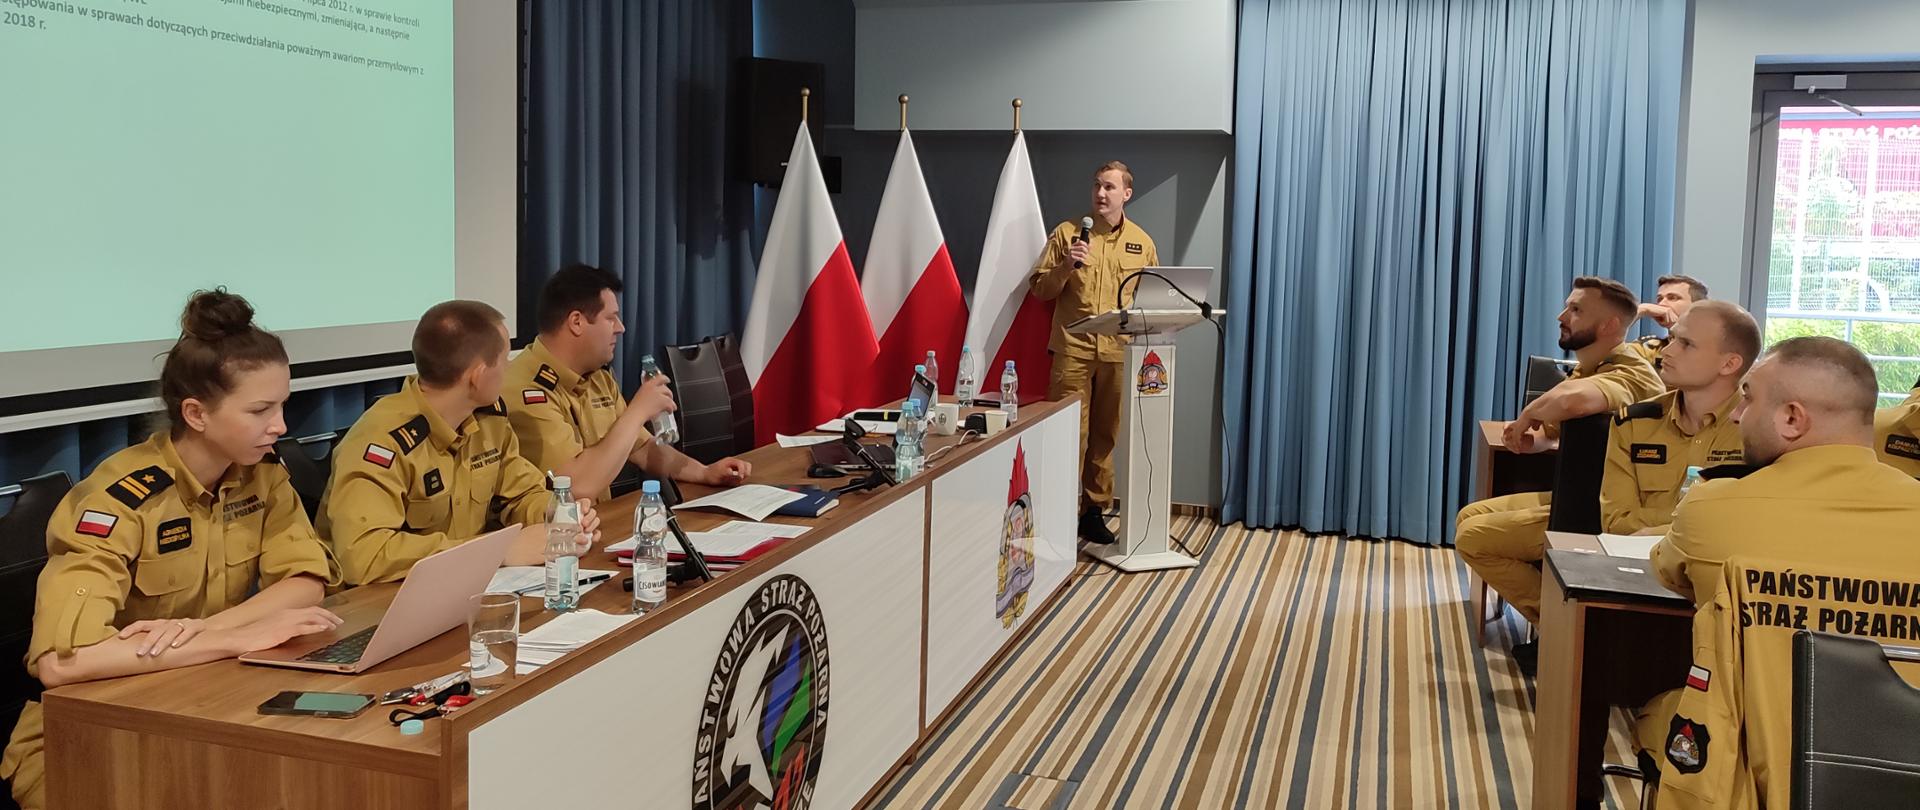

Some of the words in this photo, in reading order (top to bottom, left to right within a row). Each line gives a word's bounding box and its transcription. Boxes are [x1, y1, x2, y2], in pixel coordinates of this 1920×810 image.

[3, 11, 36, 28] 2018
[39, 20, 47, 30] r.
[329, 0, 348, 12] 2012
[356, 7, 363, 15] w
[364, 8, 392, 21] sprawie
[393, 13, 420, 28] kontroli
[78, 6, 88, 16] w
[91, 9, 143, 26] sprawach
[147, 16, 208, 37] dotyczących
[287, 43, 331, 60] poważnym
[332, 51, 366, 65] awariom
[369, 25, 374, 33] a
[375, 26, 410, 40] następnie
[1745, 568, 1920, 608] PAŃSTWOWA
[1740, 601, 1808, 630] STRAŻ
[760, 578, 808, 614] STRAŻ
[805, 597, 830, 729] POŻARNA
